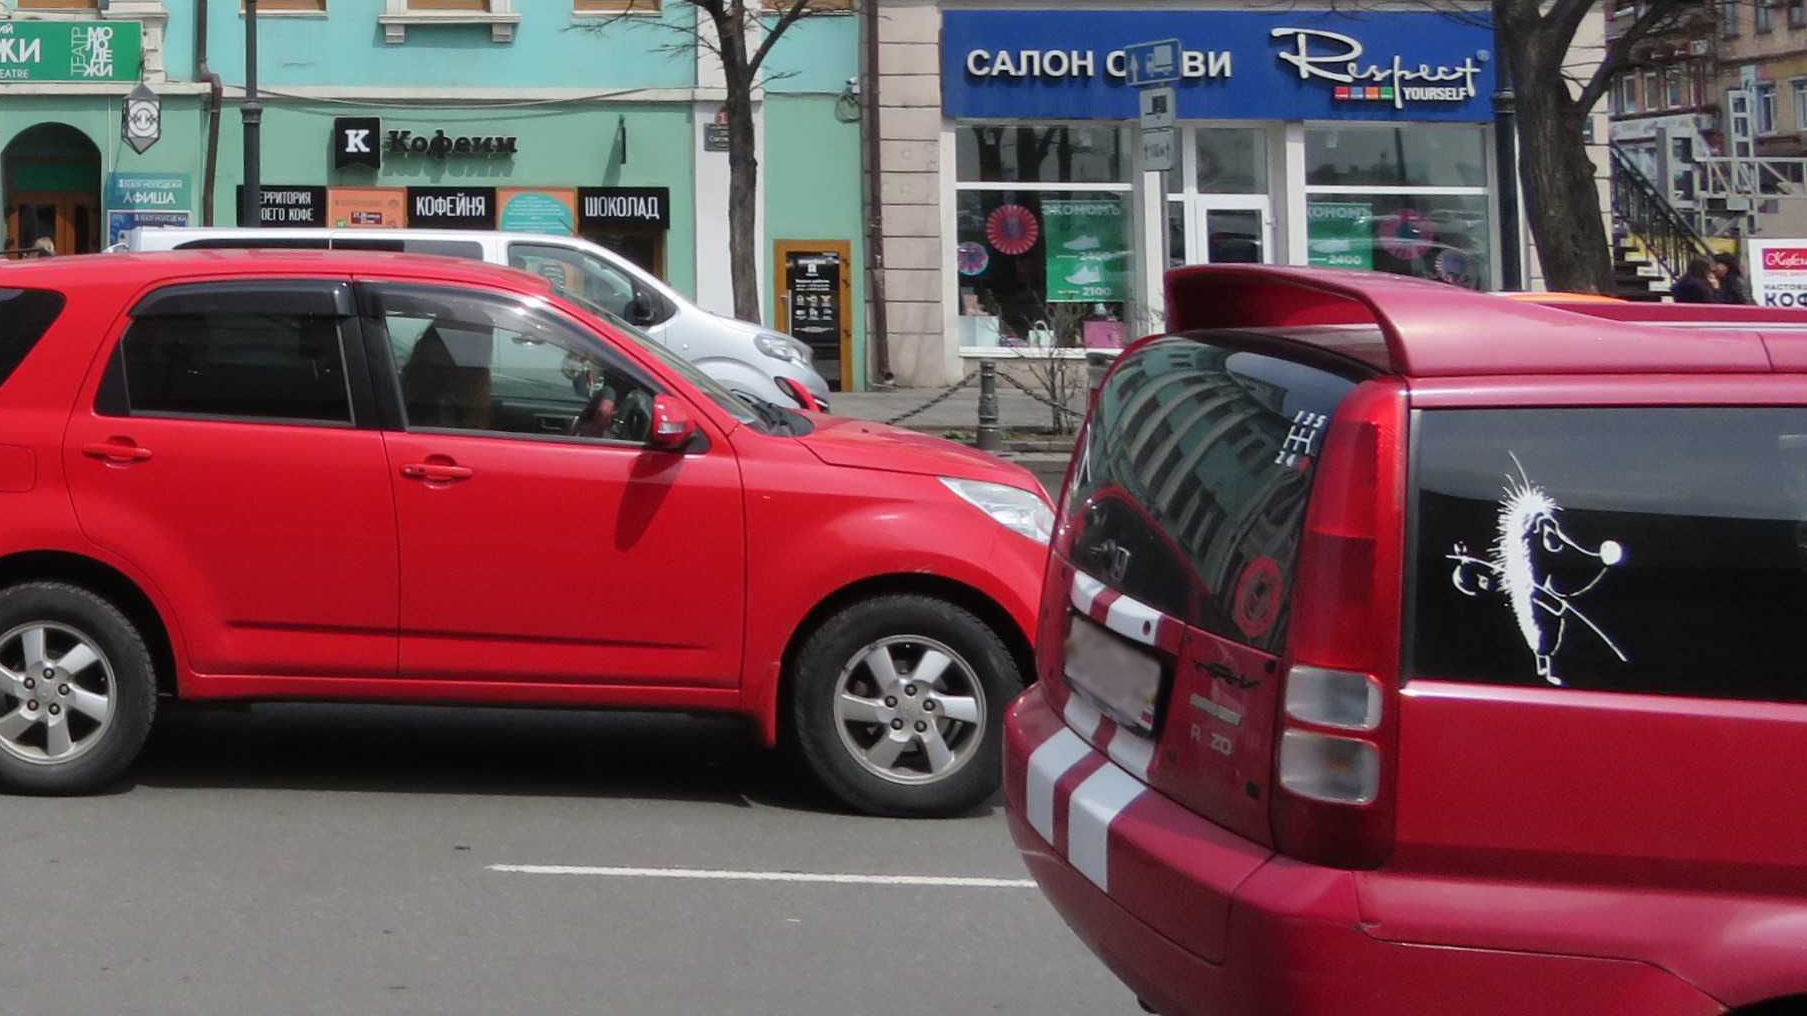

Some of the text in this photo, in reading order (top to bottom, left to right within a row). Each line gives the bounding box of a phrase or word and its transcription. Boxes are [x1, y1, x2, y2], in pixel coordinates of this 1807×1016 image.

[966, 49, 1232, 78] САЛОН ОВИ
[1271, 27, 1481, 109] Respect
[1402, 86, 1467, 101] YOURSELF
[384, 129, 518, 159] Кофеин
[122, 191, 176, 205] АФИША
[258, 190, 312, 205] ЕРРИТОРИЯ
[415, 193, 486, 217] КОФЕЙНЯ
[260, 207, 314, 222] ОЕГО КОФЕ
[584, 195, 660, 220] ШОКОЛАД
[1328, 255, 1363, 265] 2400
[1081, 287, 1112, 297] 2100
